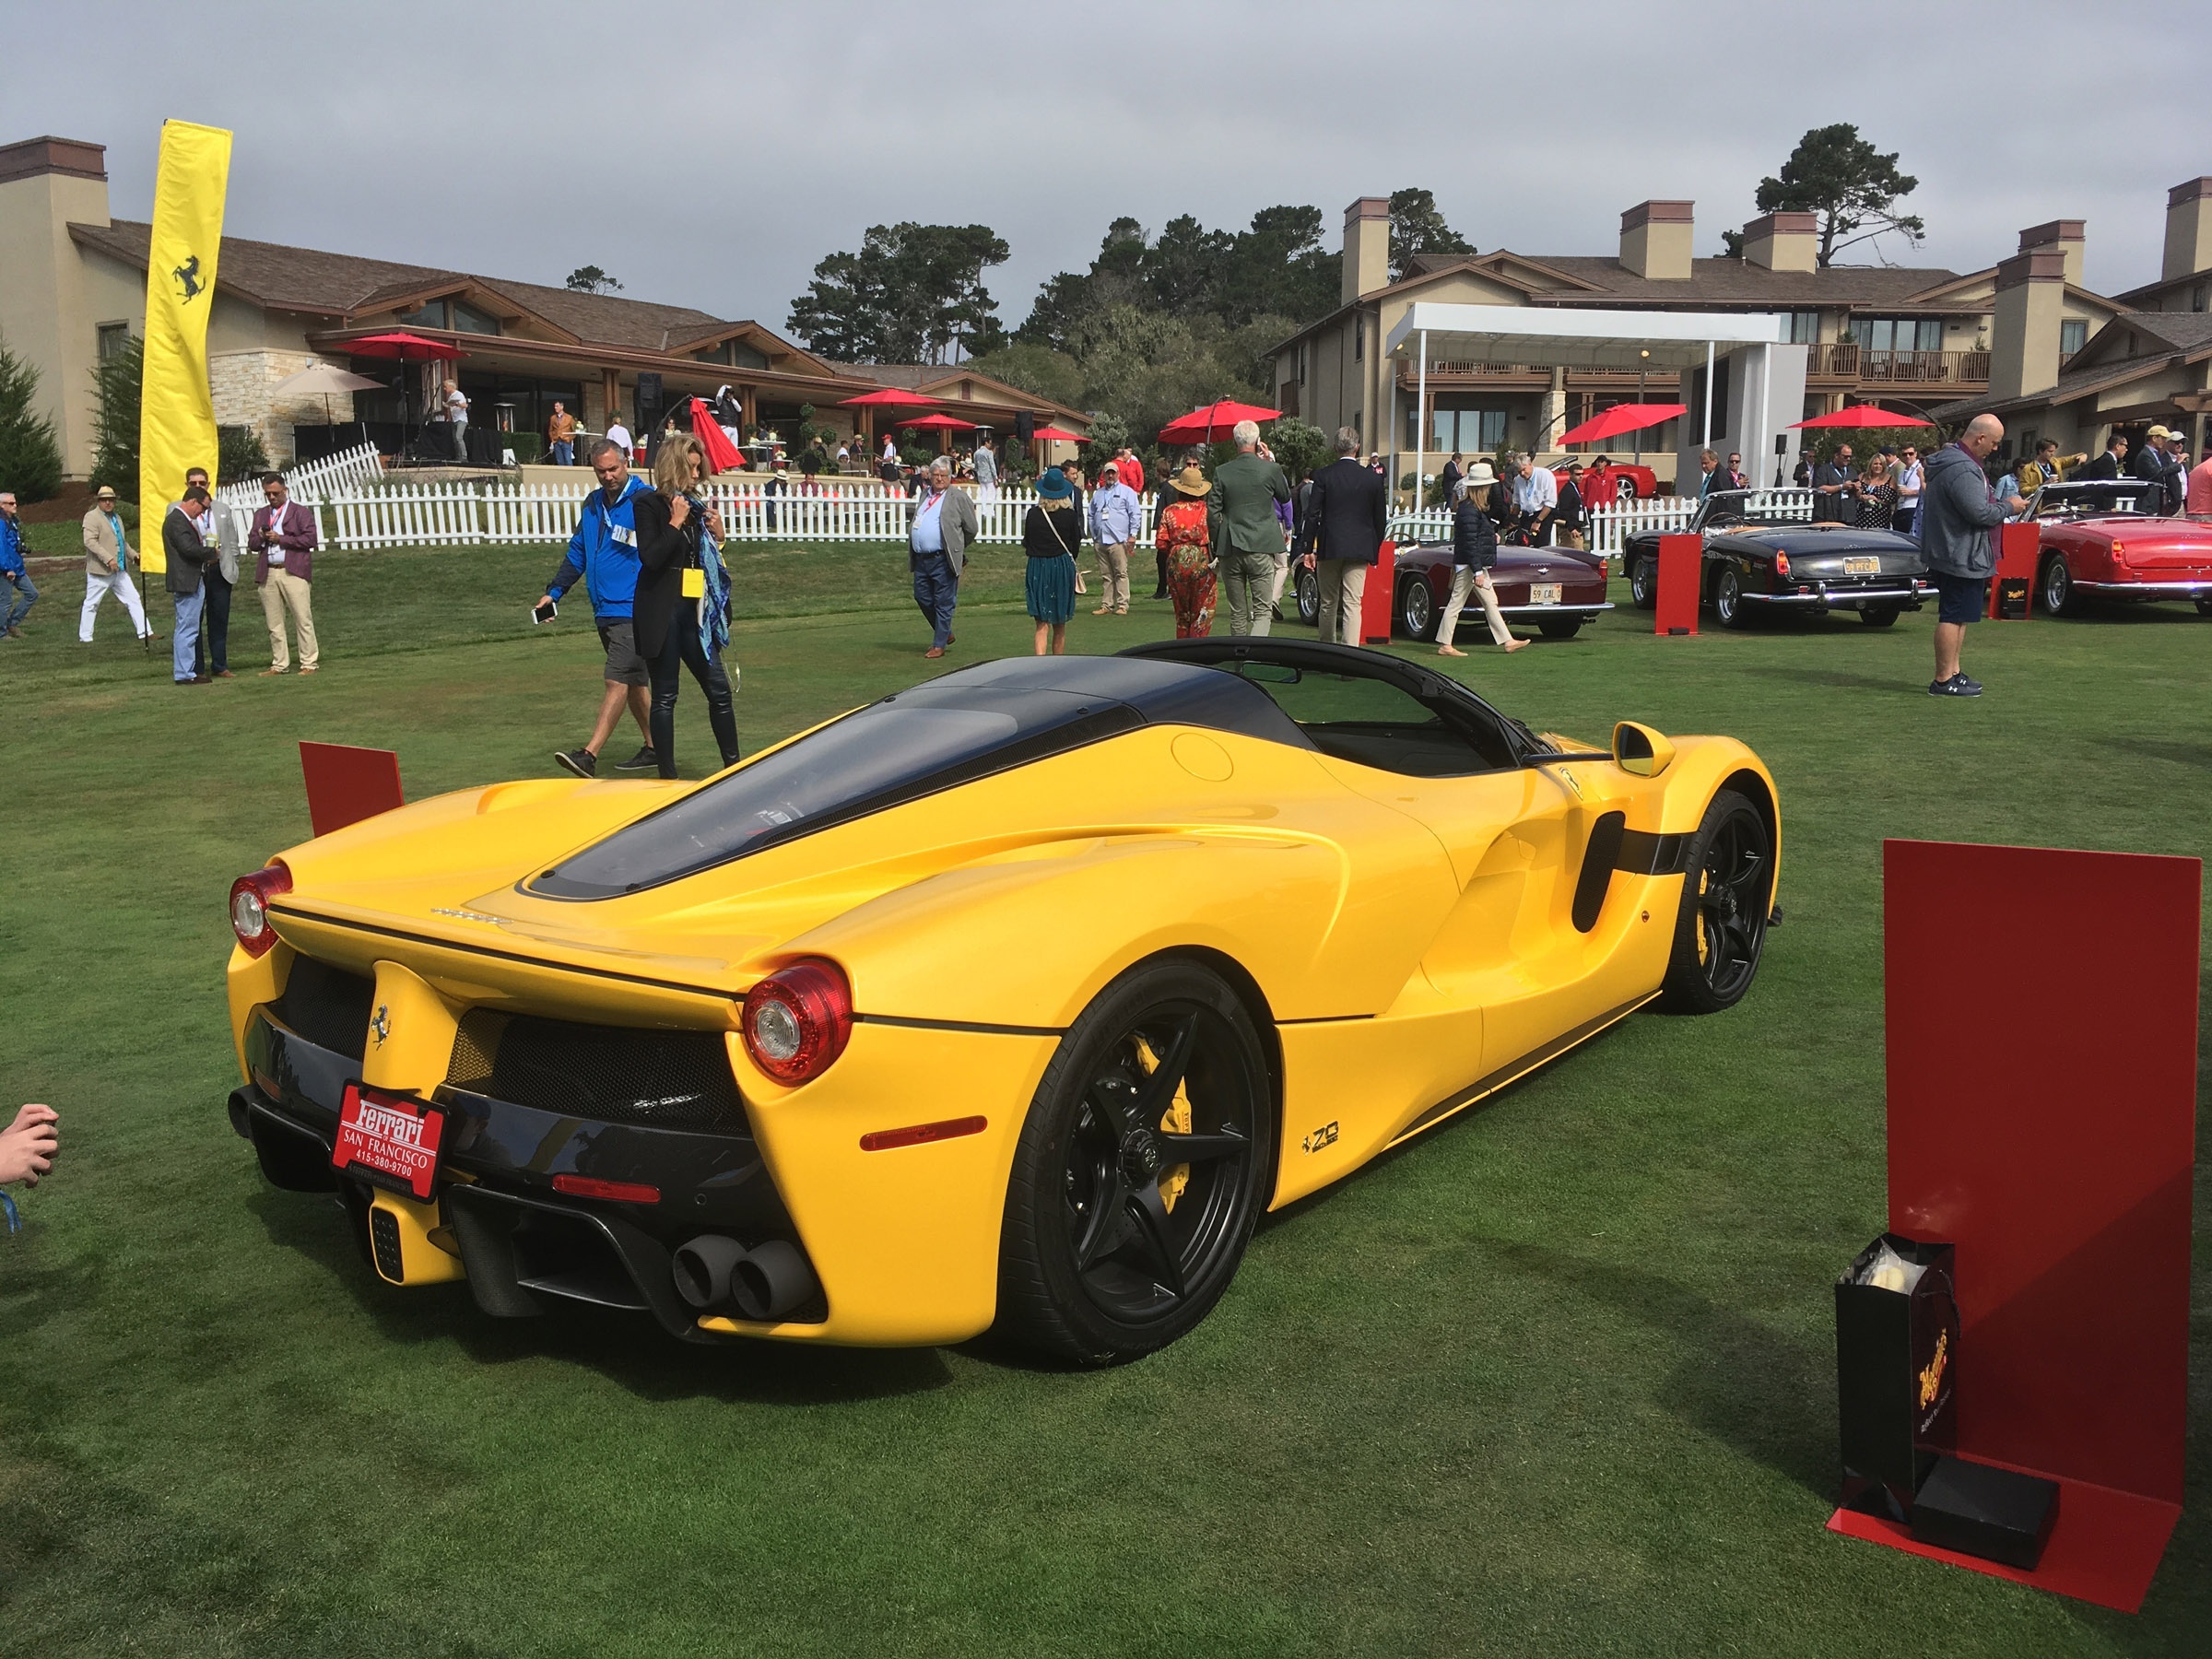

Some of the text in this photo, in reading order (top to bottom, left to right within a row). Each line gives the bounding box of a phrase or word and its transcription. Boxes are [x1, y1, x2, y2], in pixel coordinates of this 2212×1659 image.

[1846, 563, 1853, 571] 59
[1533, 590, 1555, 599] 59 CAL
[356, 1100, 424, 1146] Ferrari
[344, 1129, 428, 1169] SAN FRANCISCO
[356, 1149, 412, 1177] 415-380-9700
